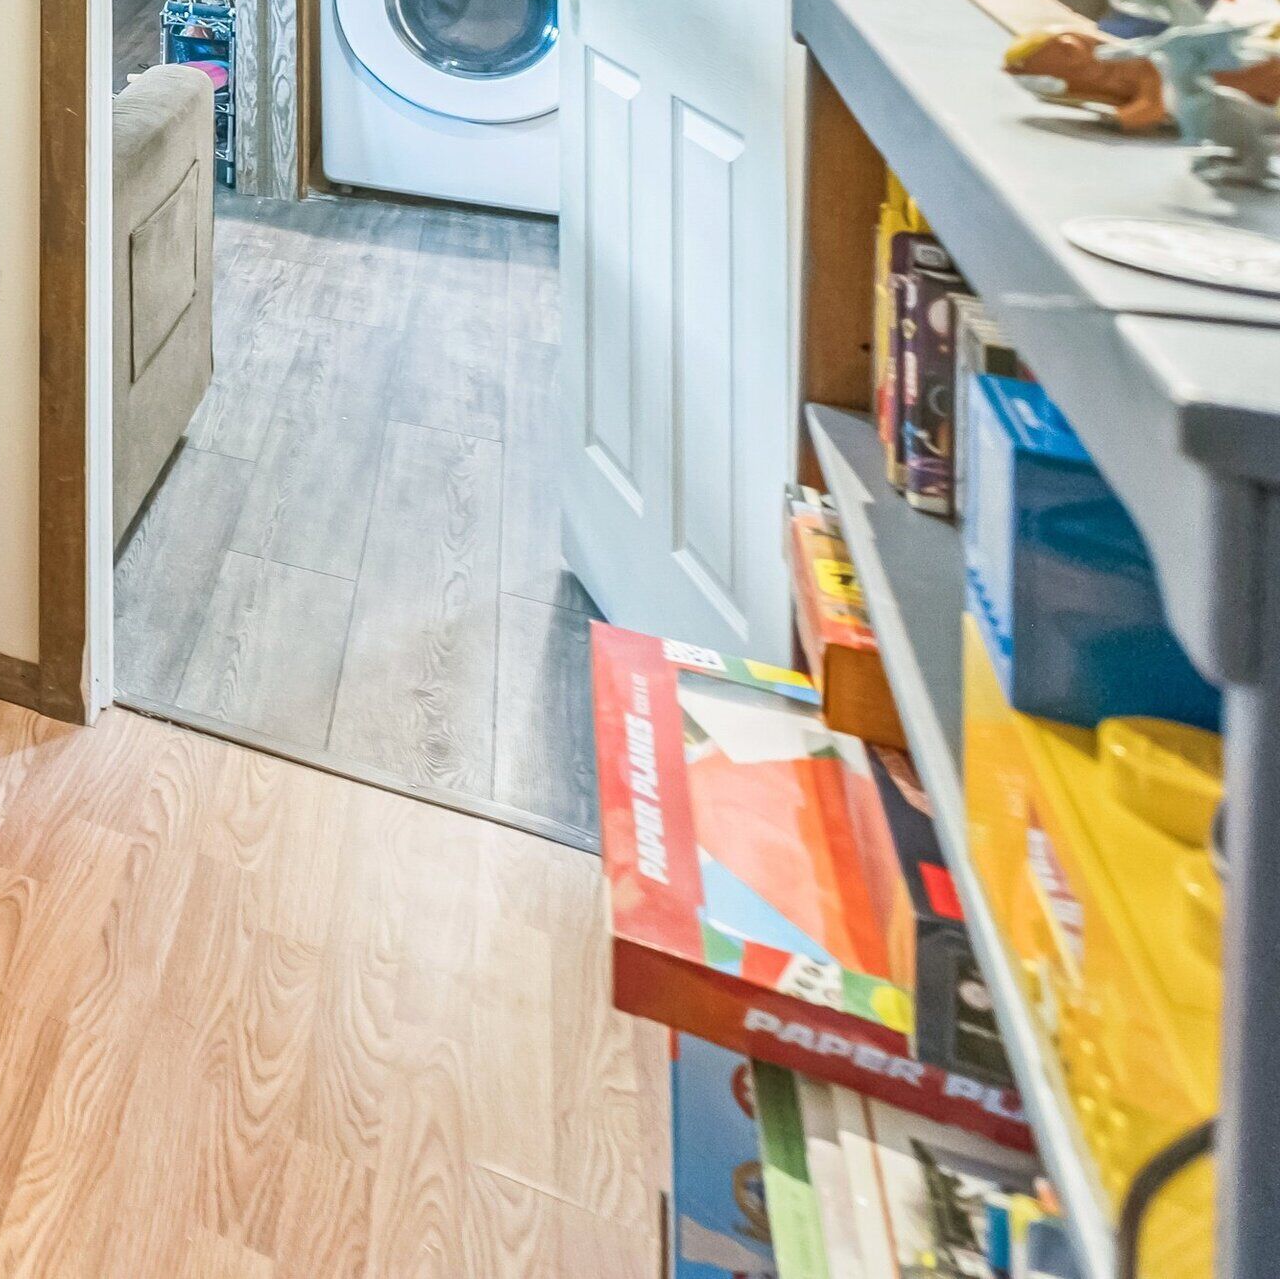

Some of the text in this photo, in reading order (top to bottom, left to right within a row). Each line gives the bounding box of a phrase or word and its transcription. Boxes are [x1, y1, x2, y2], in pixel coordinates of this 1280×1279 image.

[624, 712, 661, 802] PLANES
[631, 797, 670, 886] PAPER
[743, 1007, 1025, 1120] PAPER PL
